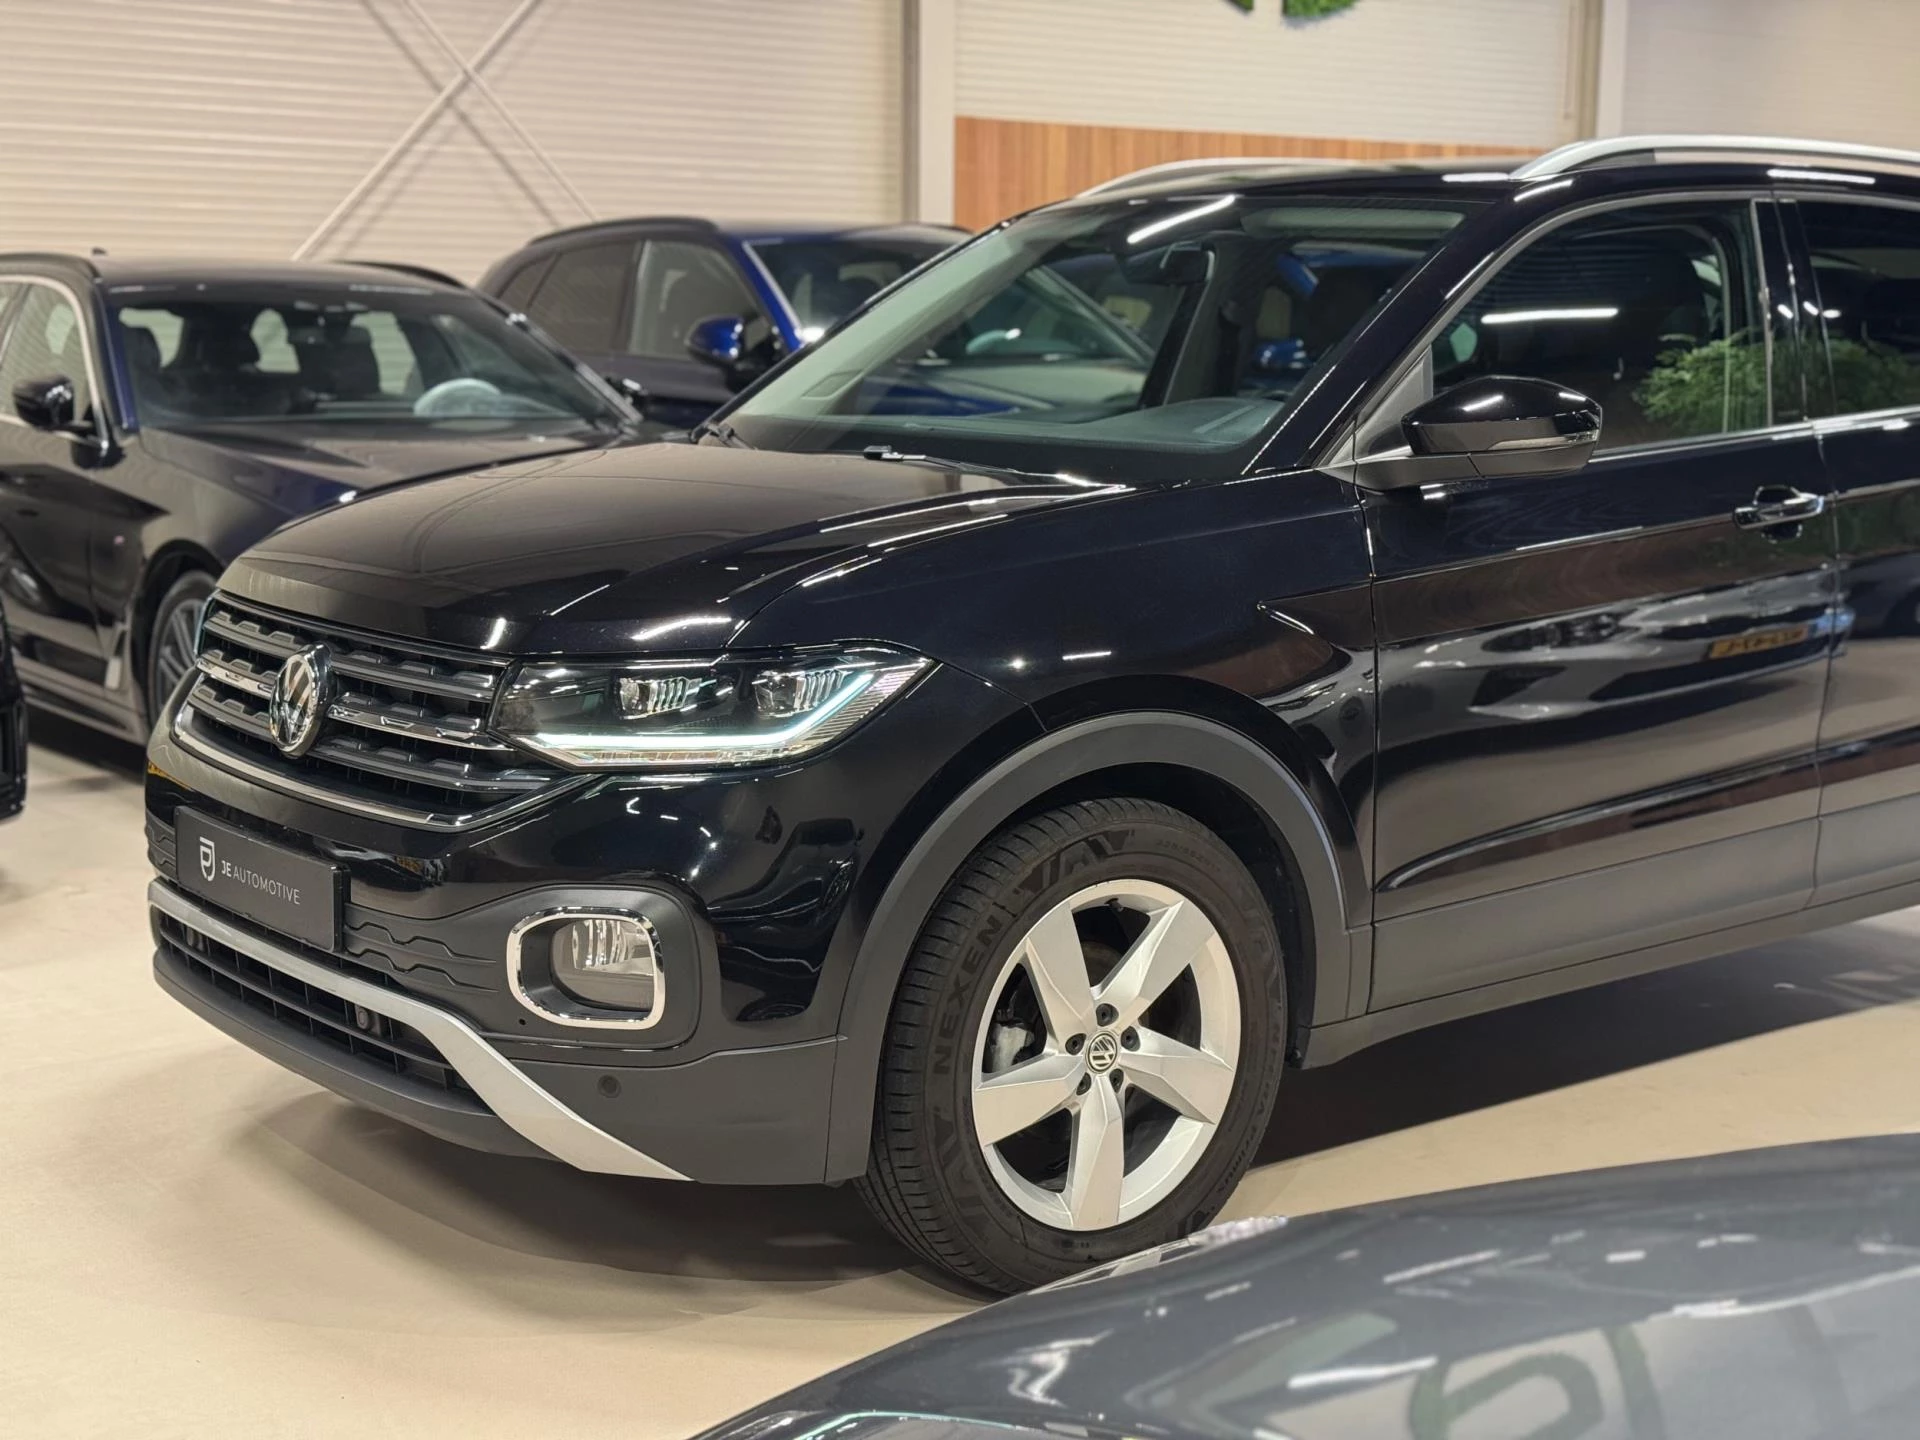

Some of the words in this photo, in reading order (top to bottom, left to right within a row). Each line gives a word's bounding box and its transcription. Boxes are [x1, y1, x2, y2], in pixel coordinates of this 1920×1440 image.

[221, 860, 232, 877] JE
[233, 864, 300, 905] AUTOMOTIVE
[935, 914, 1001, 1075] NEXEN
